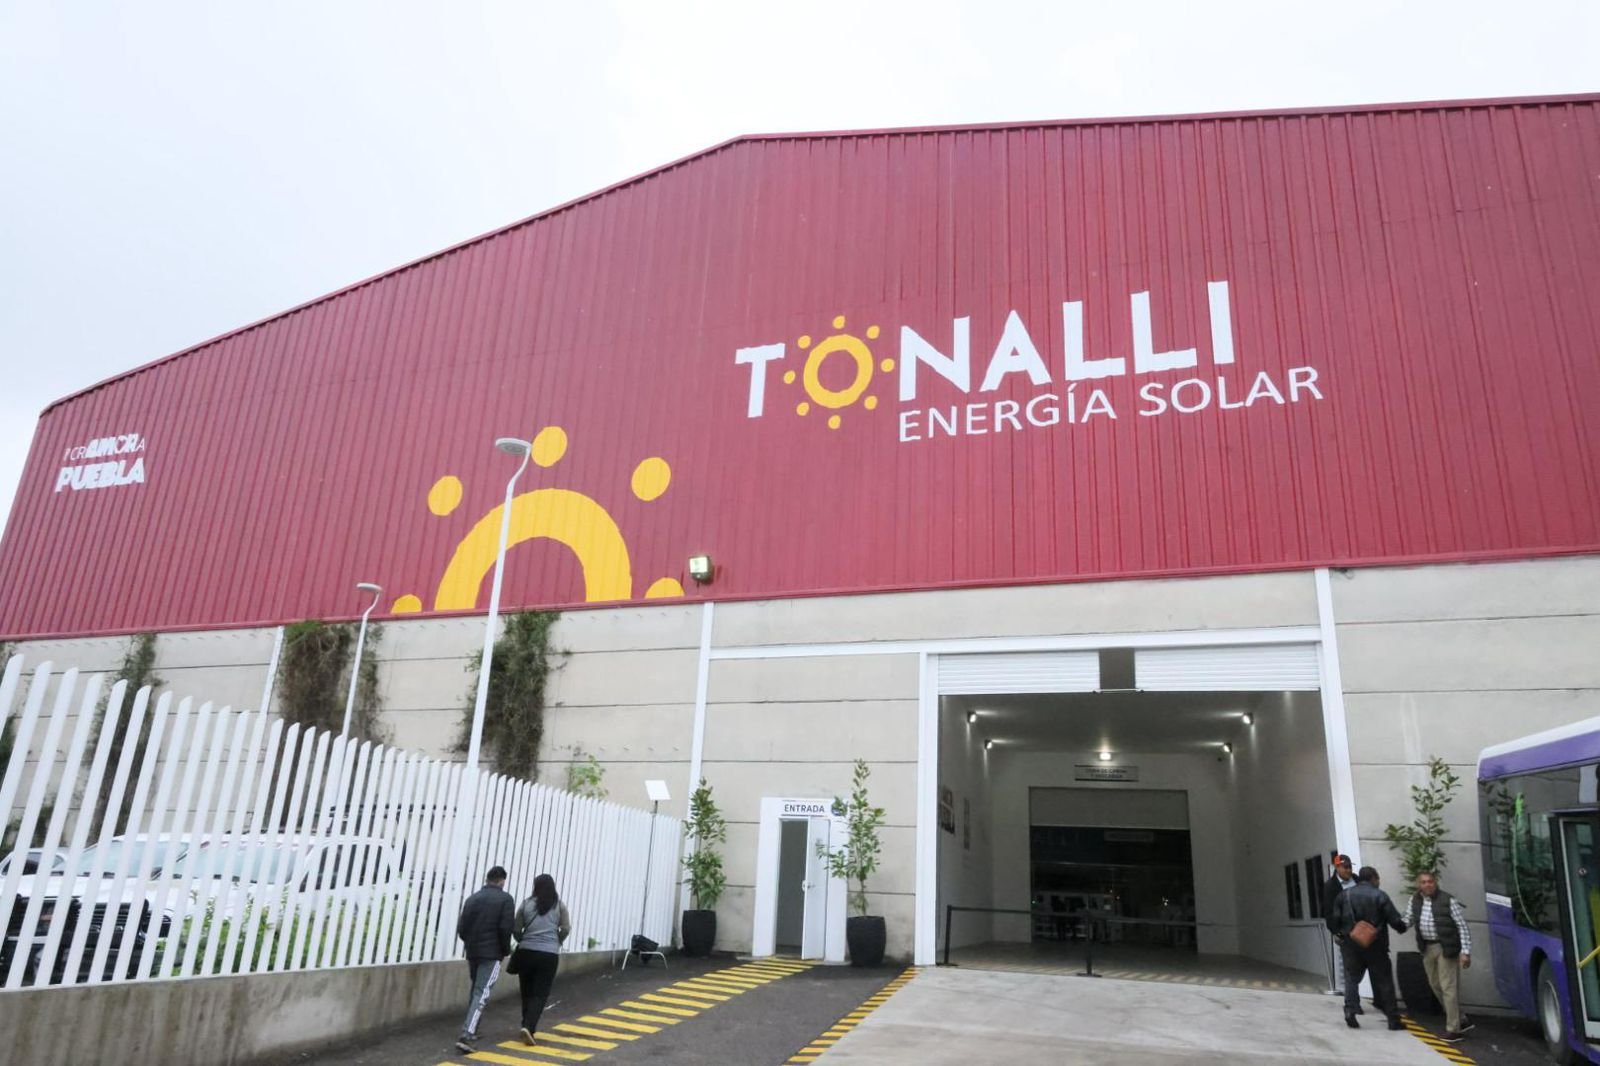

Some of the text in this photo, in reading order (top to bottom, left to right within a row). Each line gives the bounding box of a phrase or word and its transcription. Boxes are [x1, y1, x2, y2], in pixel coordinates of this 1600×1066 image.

[735, 280, 1235, 419] TONALLI
[898, 365, 1324, 443] ENERGÍA SOLAR
[55, 457, 145, 493] PUEBLA
[784, 804, 825, 813] ENTRADA
